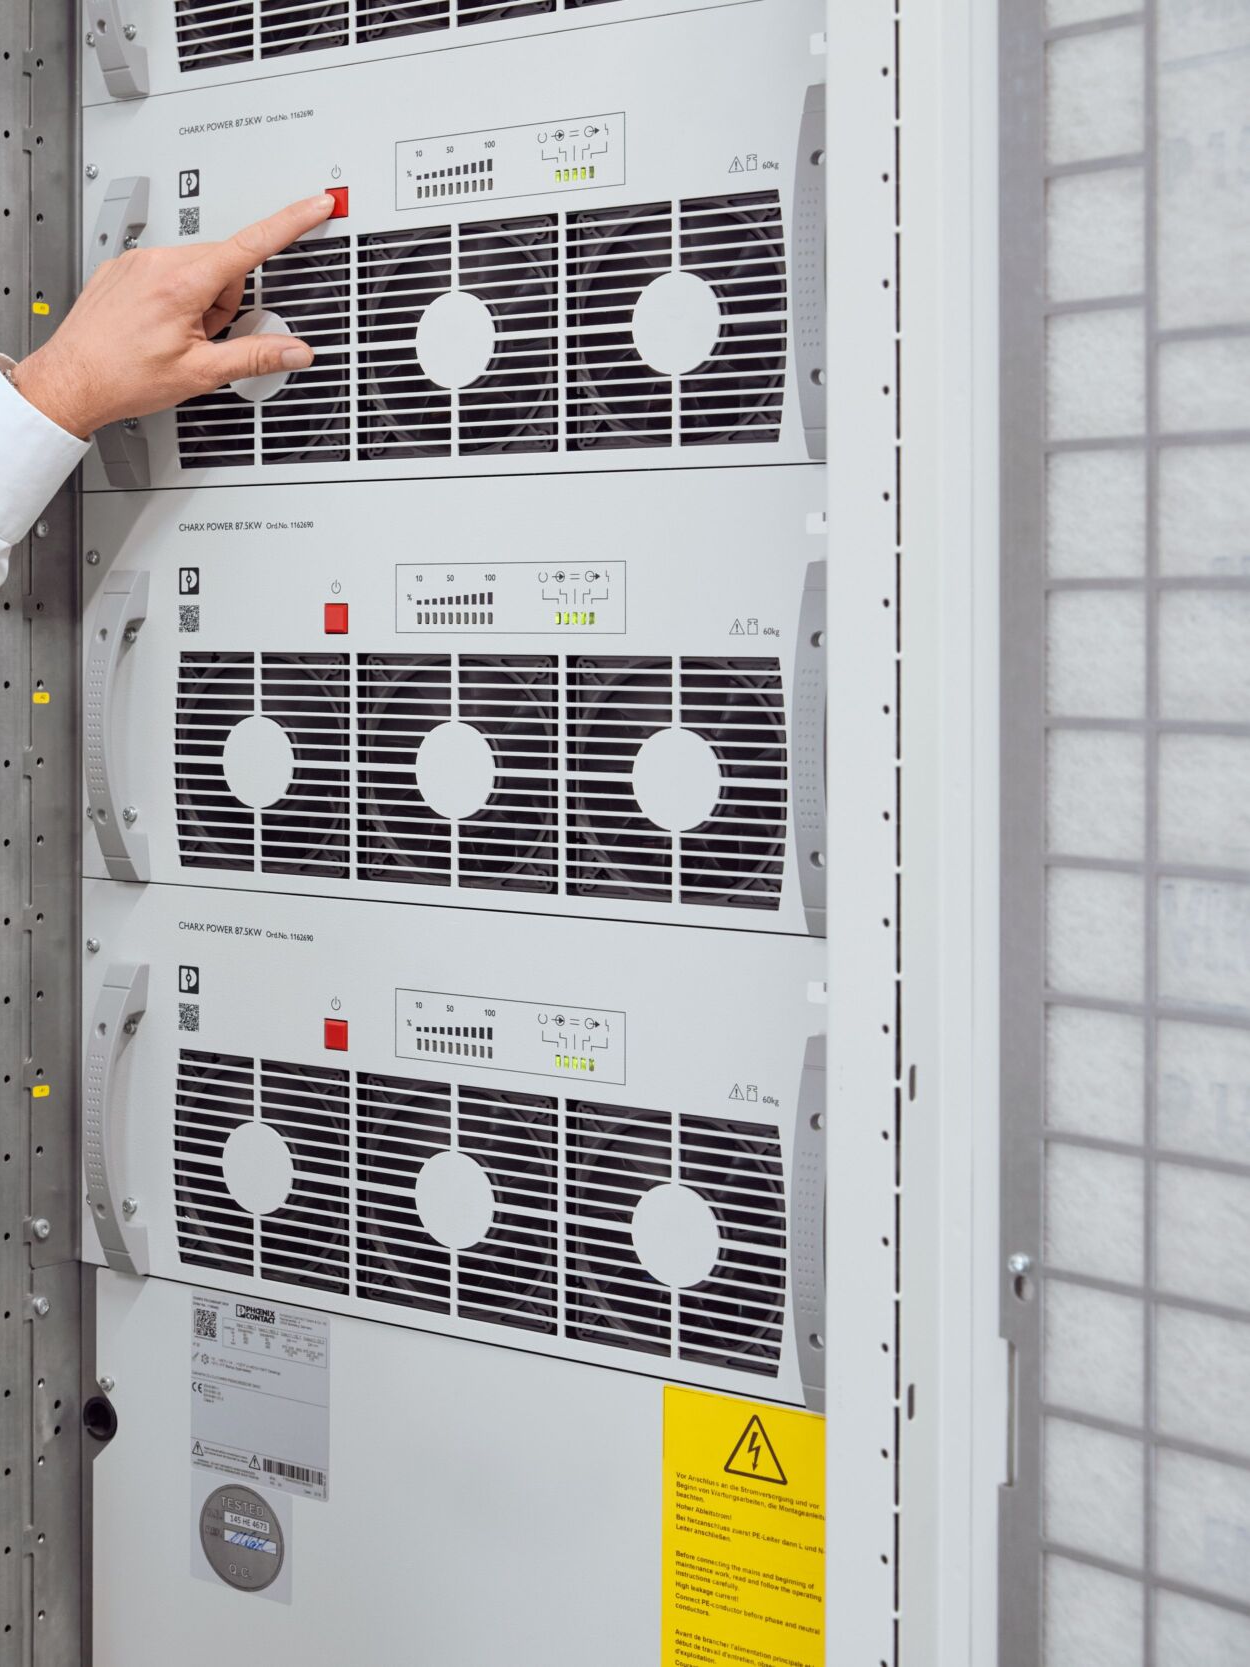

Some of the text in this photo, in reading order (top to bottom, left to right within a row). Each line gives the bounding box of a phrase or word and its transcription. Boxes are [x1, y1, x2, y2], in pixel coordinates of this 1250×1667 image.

[179, 124, 205, 135] CHARX
[206, 120, 233, 131] POWER
[235, 116, 262, 127] 87.5KW
[290, 109, 314, 119] 1162690
[446, 146, 454, 154] 50
[484, 140, 496, 149] 100
[762, 161, 780, 170] 60kg
[179, 523, 205, 532] CHARX
[206, 522, 233, 531] POWER
[235, 521, 262, 530] 87.5KW
[290, 521, 314, 529] 1162690
[446, 574, 455, 582] 50
[763, 627, 780, 638] 60kg
[179, 921, 205, 932] CHARX
[206, 924, 233, 935] POWER
[234, 926, 262, 937] 87.5KW
[290, 933, 314, 942] 1162690
[415, 1001, 496, 1017] 10 50 100
[762, 1095, 780, 1107] 60kg
[245, 1312, 275, 1324] CONTACT
[192, 1381, 203, 1394] CE
[676, 1481, 697, 1492] Beginn
[767, 1502, 777, 1510] die
[688, 1474, 720, 1487] Anschluss
[740, 1486, 794, 1505] Stromversorgung
[795, 1499, 808, 1507] und
[221, 1496, 264, 1518] TESTED
[676, 1502, 732, 1521] Hoher Ableitstrom!
[230, 1514, 241, 1524] 145
[242, 1519, 251, 1527] HE
[252, 1521, 268, 1531] 4673
[675, 1524, 693, 1533] Leiter
[676, 1513, 686, 1521] Bei
[732, 1528, 751, 1537] zuerst
[751, 1531, 781, 1544] PE-Leiter
[781, 1538, 798, 1547] dann
[804, 1544, 817, 1553] und
[675, 1550, 815, 1590] Before connecting the mains and beginning of
[675, 1569, 711, 1584] instructions
[675, 1560, 713, 1575] maintenance
[732, 1574, 747, 1583] read
[747, 1577, 759, 1585] and
[760, 1580, 780, 1591] follow
[780, 1586, 791, 1594] the
[792, 1589, 822, 1603] operating
[675, 1581, 690, 1591] High
[690, 1584, 714, 1597] leakage
[675, 1592, 821, 1636] Connect PE-conductor before phase and neutral
[675, 1628, 693, 1639] Avant
[702, 1635, 730, 1648] brancher
[730, 1642, 772, 1660] l'alimentation
[693, 1643, 701, 1651] de
[702, 1645, 721, 1657] travail
